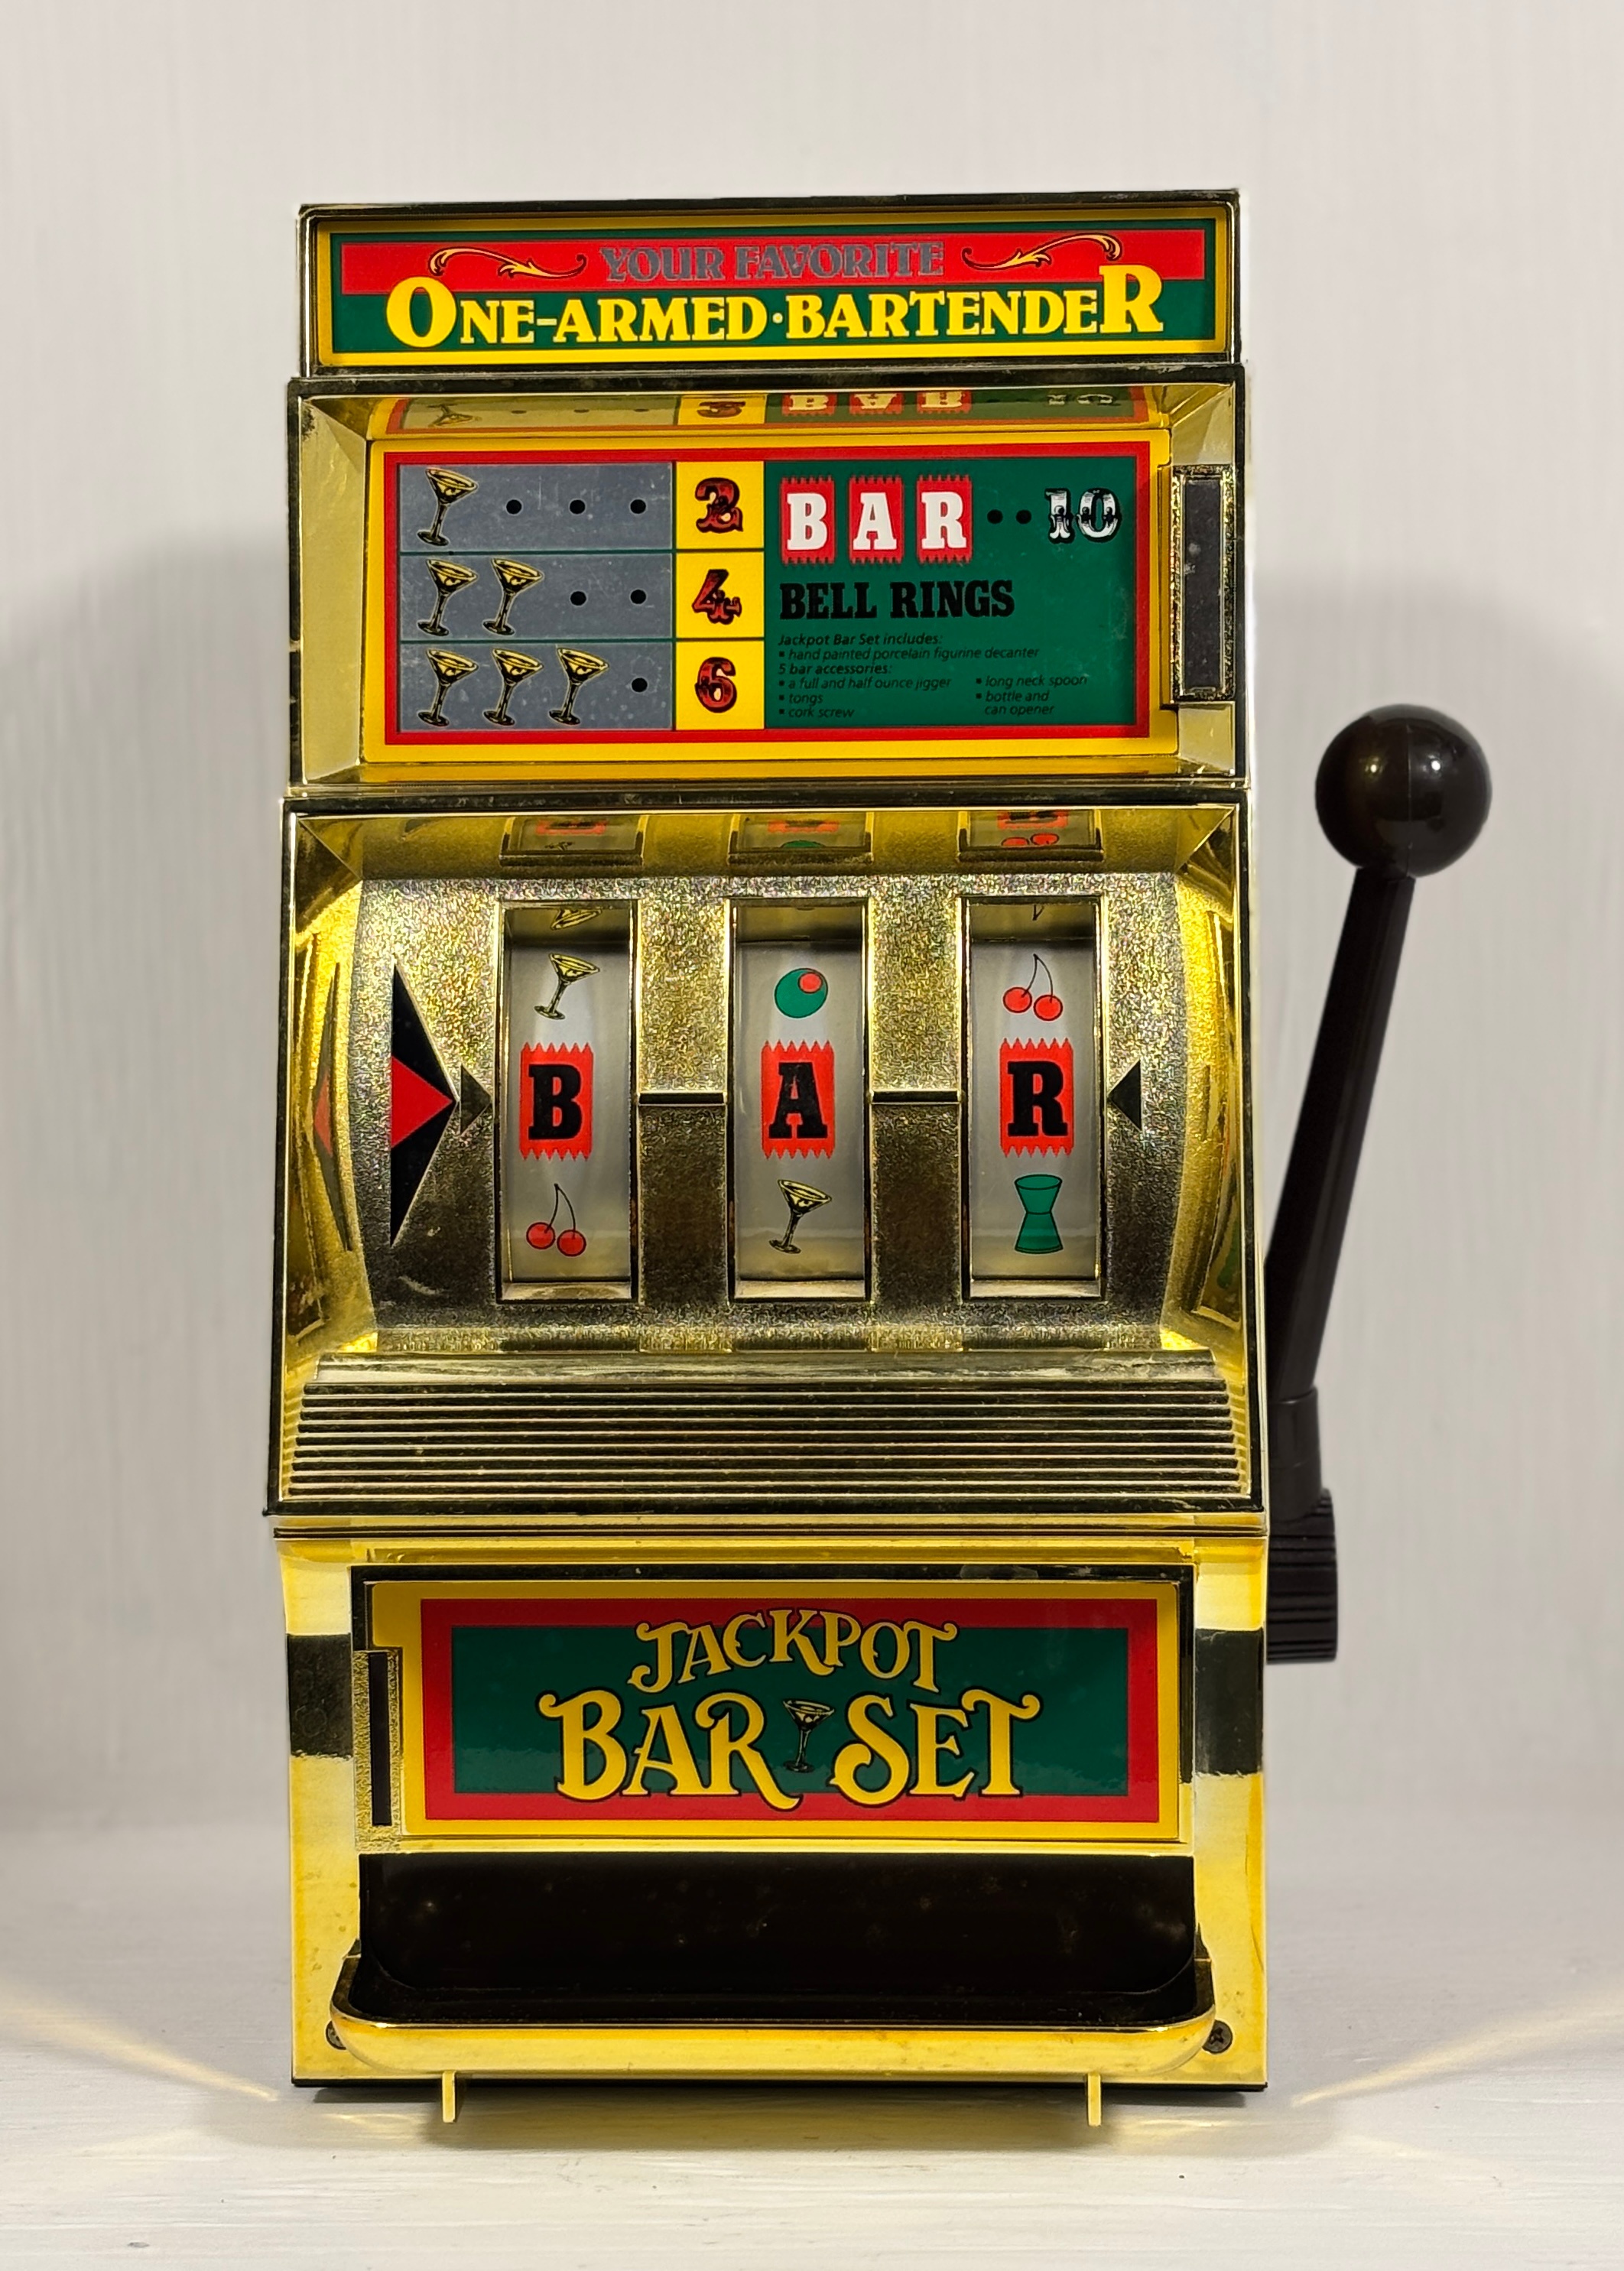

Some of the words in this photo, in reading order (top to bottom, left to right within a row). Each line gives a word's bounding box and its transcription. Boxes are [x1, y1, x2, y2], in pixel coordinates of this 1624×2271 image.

[599, 243, 724, 283] YOUR
[734, 242, 945, 281] FAVORITE
[386, 275, 768, 348] ONE-ARMED
[784, 265, 1164, 341] BARTENDER
[694, 477, 744, 533] 2
[1044, 487, 1123, 543] 10
[691, 568, 742, 625] 4
[778, 582, 878, 620] BELL
[890, 579, 1016, 619] RINGS
[778, 634, 830, 648] Jackpot
[833, 635, 856, 645] Bar
[859, 634, 880, 645] Set
[883, 632, 943, 645] includes:
[778, 663, 786, 674] 5
[789, 663, 812, 674] bar
[815, 661, 893, 674] accessories:
[788, 648, 820, 660] hand
[822, 648, 872, 662] painted
[872, 648, 931, 661] porcelain
[933, 647, 982, 662] figurine
[984, 648, 1040, 659] decanter
[694, 656, 737, 713] 6
[788, 681, 796, 689] a
[798, 677, 820, 689] full
[821, 677, 846, 689] and
[848, 676, 873, 689] half
[874, 677, 914, 688] ounce
[914, 677, 952, 691] jigger
[985, 675, 1014, 689] long
[1015, 674, 1045, 686] neck
[1048, 676, 1088, 687] spoon
[788, 694, 823, 706] tongs
[984, 706, 1007, 715] can
[1009, 705, 1054, 716] opener
[985, 690, 1022, 703] bottle
[1025, 690, 1050, 702] and
[788, 706, 814, 718] cork
[817, 708, 855, 718] screw
[627, 1607, 959, 1696] JACKPOT
[535, 1687, 803, 1812] BAR
[827, 1687, 1043, 1809] SET
